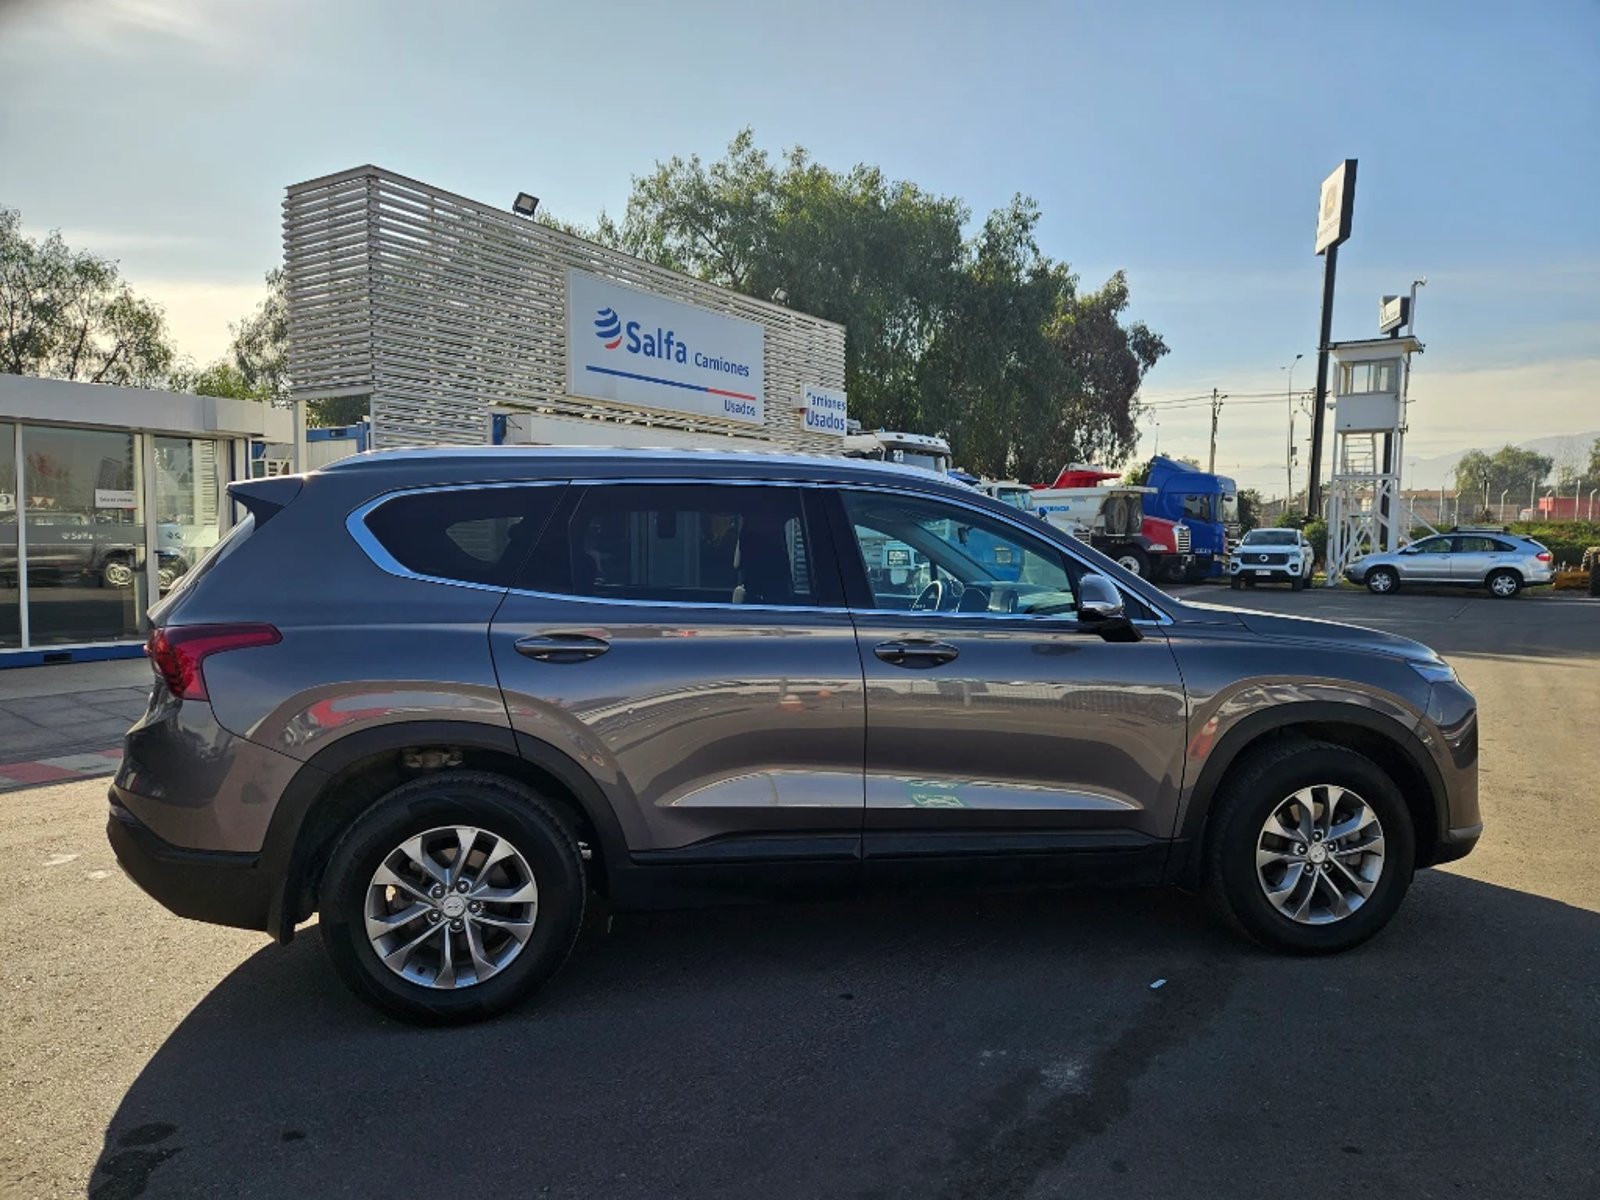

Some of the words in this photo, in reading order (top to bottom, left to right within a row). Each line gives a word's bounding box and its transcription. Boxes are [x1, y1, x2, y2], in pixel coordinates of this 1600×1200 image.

[626, 321, 687, 364] Salfa
[694, 352, 750, 377] Camiones
[724, 399, 756, 416] Usados
[806, 410, 845, 430] Usados
